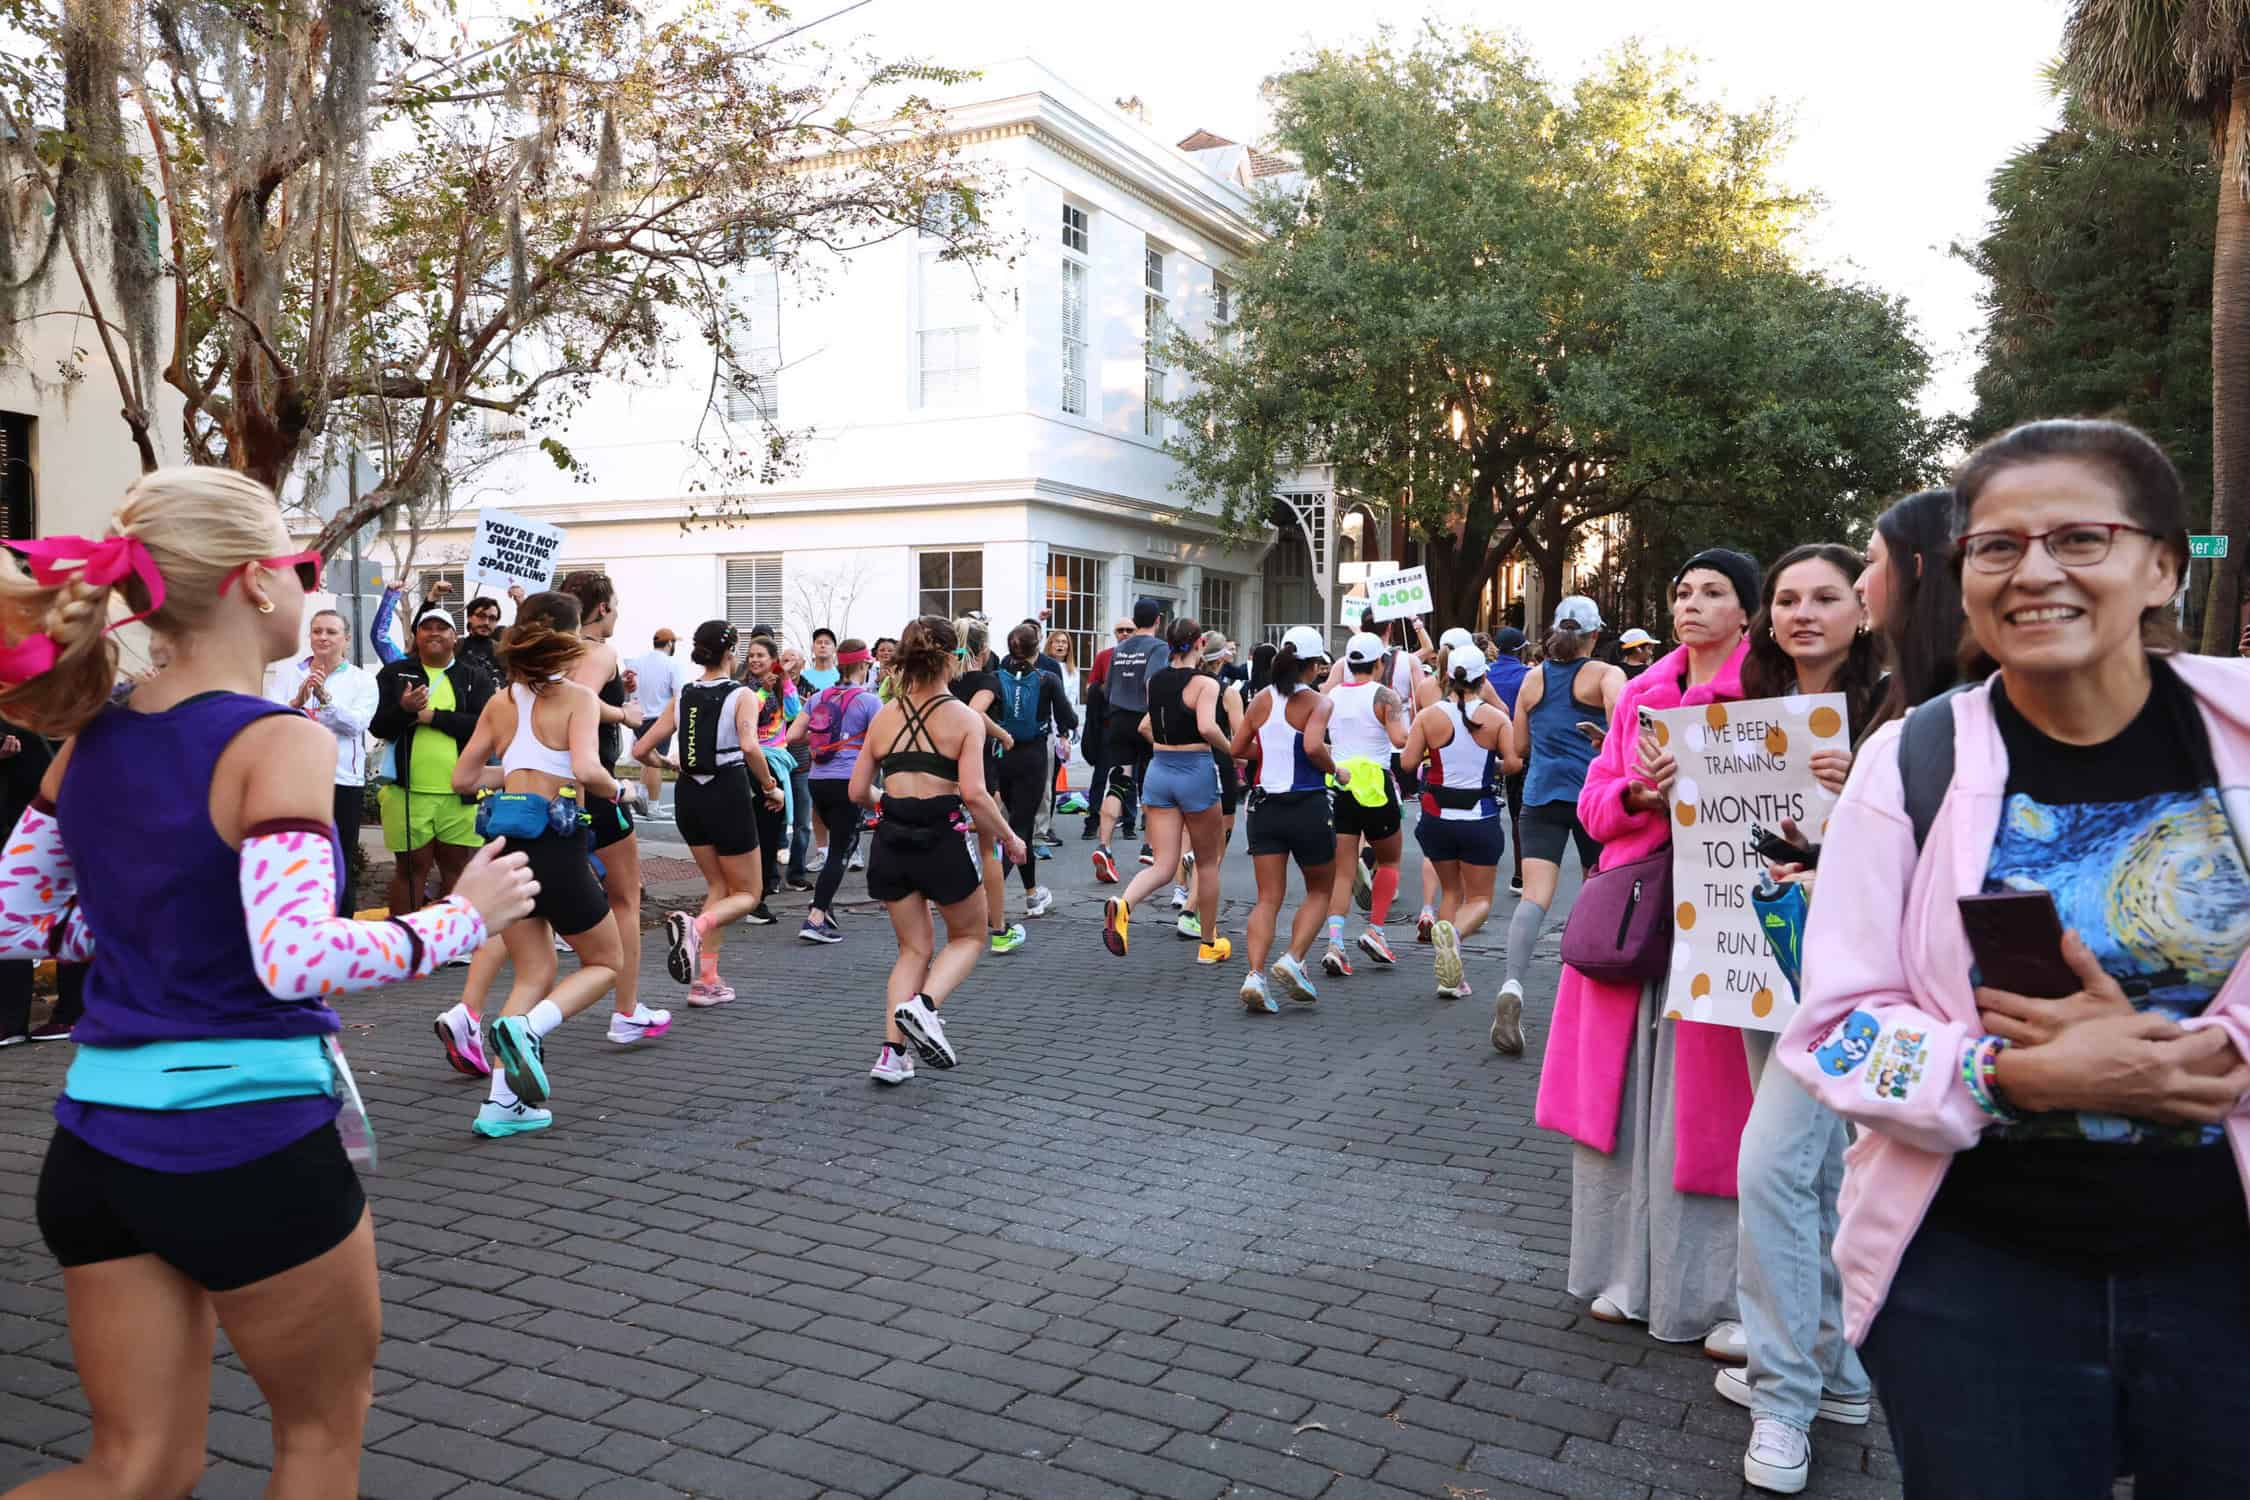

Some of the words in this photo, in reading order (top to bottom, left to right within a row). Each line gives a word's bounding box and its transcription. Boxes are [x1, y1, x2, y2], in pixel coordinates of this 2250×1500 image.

[485, 520, 535, 543] YOU'RE
[536, 535, 559, 550] NOT
[478, 556, 547, 583] SPARKLING
[496, 548, 541, 569] YOU'RE
[1377, 586, 1424, 606] 4:00
[687, 706, 698, 767] NATHAN
[1703, 723, 1732, 744] I'VE
[1736, 720, 1780, 742] BEEN
[1704, 752, 1787, 775] TRAINING
[1700, 793, 1805, 824] MONTHS
[1703, 841, 1735, 868] TO
[1704, 884, 1745, 909] THIS
[1717, 931, 1756, 955] RUN
[1726, 968, 1767, 993] RUN
